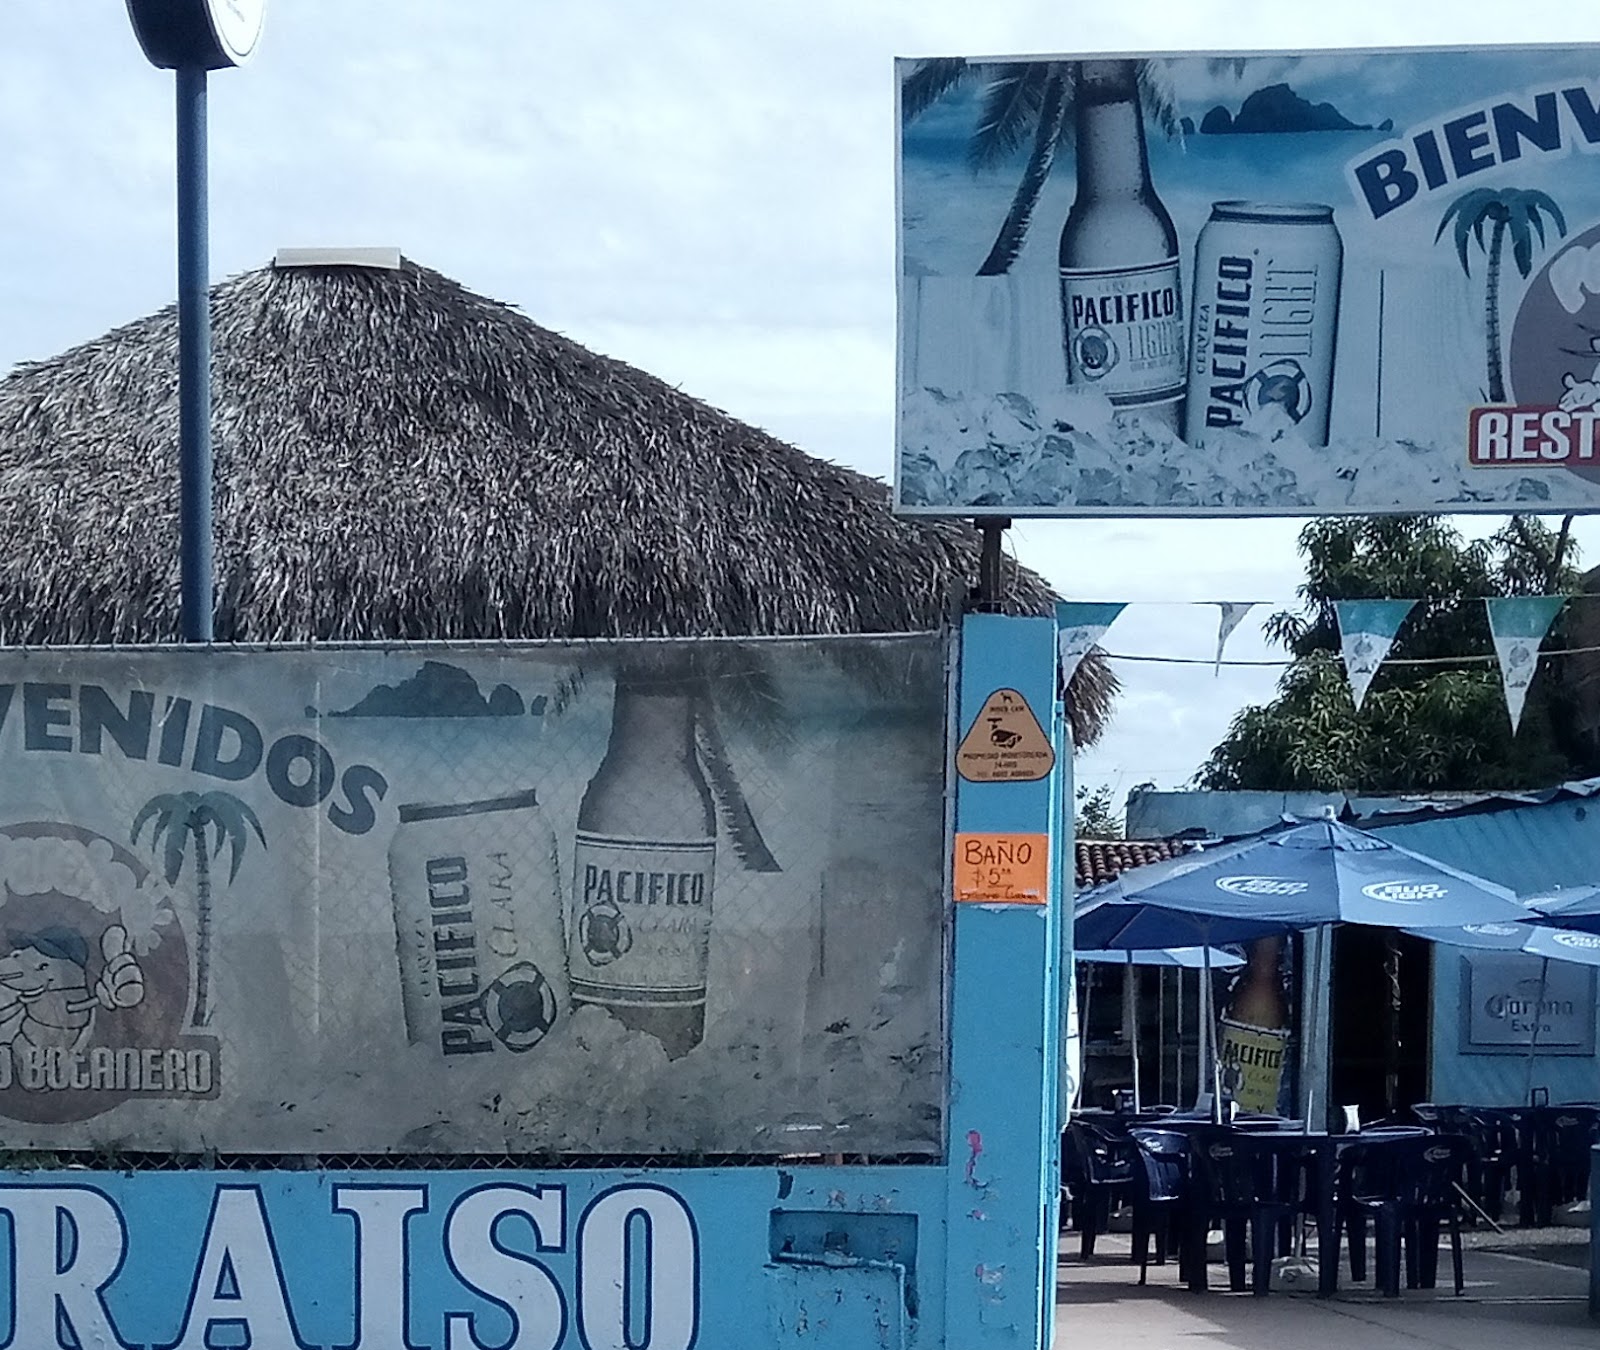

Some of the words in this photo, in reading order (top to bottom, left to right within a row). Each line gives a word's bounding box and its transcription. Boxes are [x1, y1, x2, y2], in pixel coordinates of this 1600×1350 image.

[1072, 287, 1175, 330] PACIFICO
[1258, 258, 1319, 358] LIGHT
[1196, 304, 1211, 375] CERVEZA
[1205, 256, 1253, 428] PACIFICO
[965, 839, 1032, 865] BAÑO
[486, 851, 519, 957] CLARA
[584, 864, 704, 906] PACIFICO
[1379, 889, 1449, 900] LIGHT
[1384, 884, 1440, 893] BUD
[426, 856, 494, 1056] PACIFICO
[1484, 994, 1573, 1020] Corona
